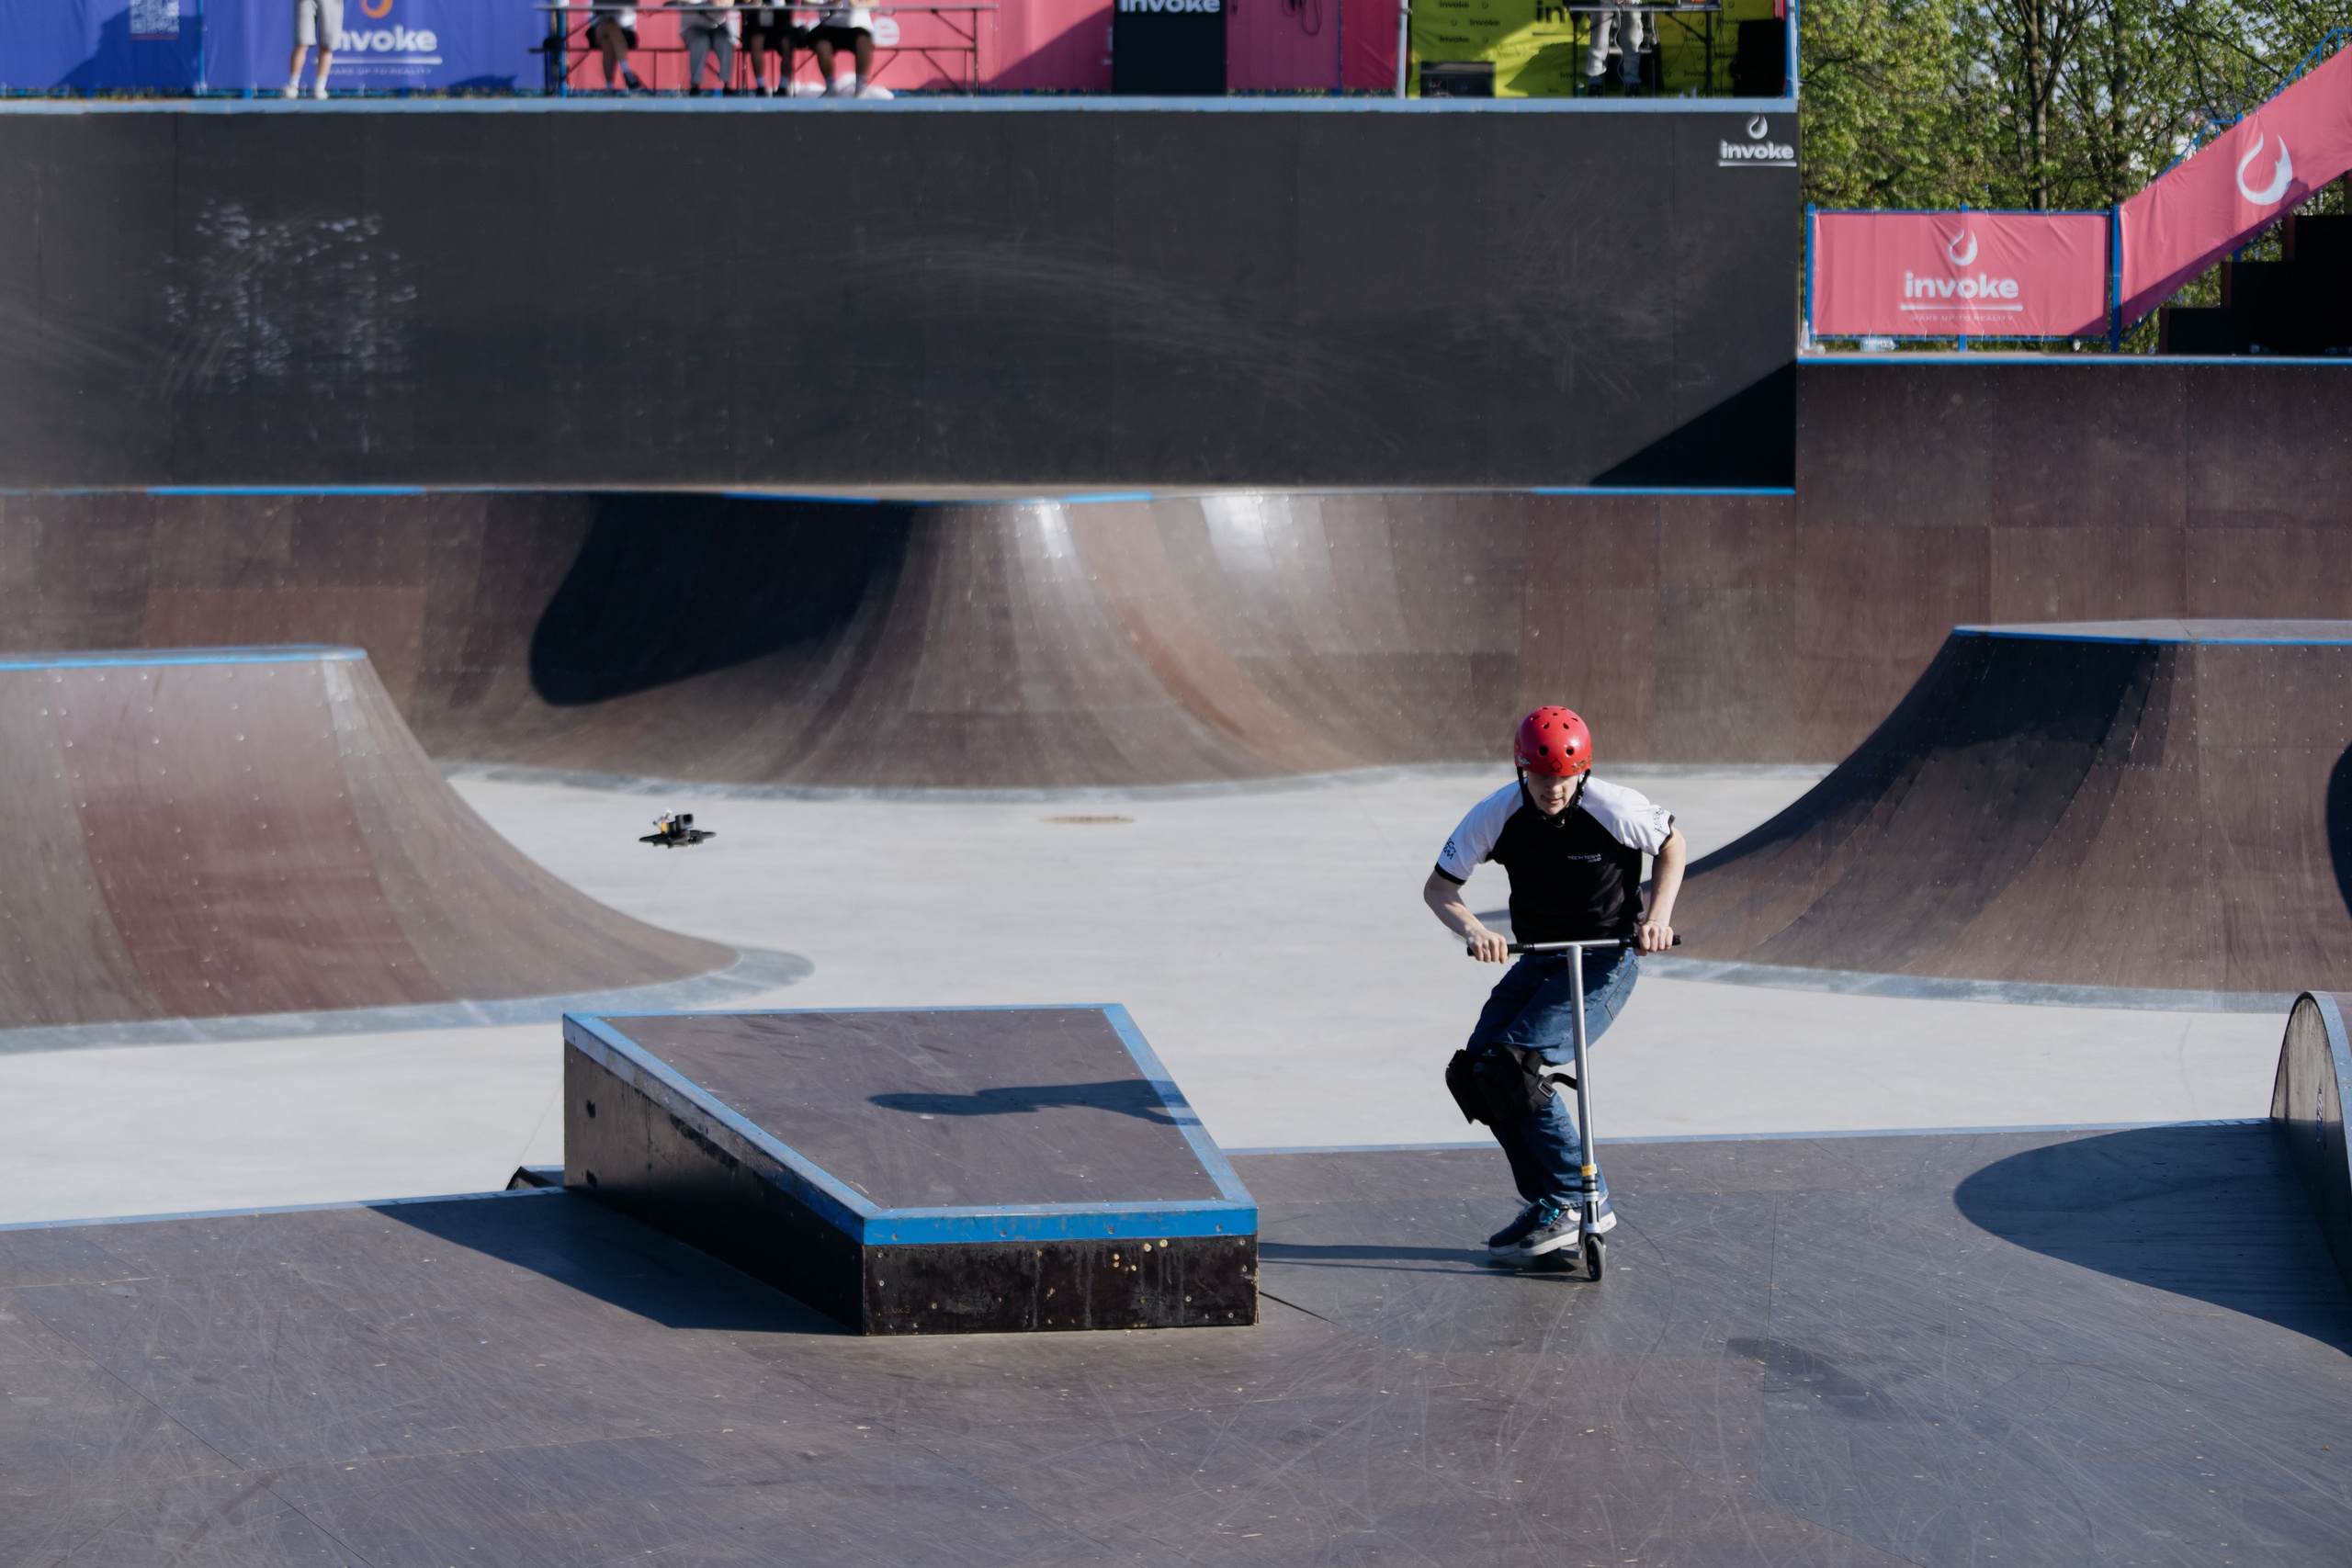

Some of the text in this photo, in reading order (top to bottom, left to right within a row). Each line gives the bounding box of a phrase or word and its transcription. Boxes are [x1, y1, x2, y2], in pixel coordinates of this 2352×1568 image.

[332, 24, 438, 51] nvoke
[1720, 139, 1794, 160] invoke
[1905, 270, 2019, 299] invoke
[1911, 314, 2014, 322] WAKE UP TO REALITY
